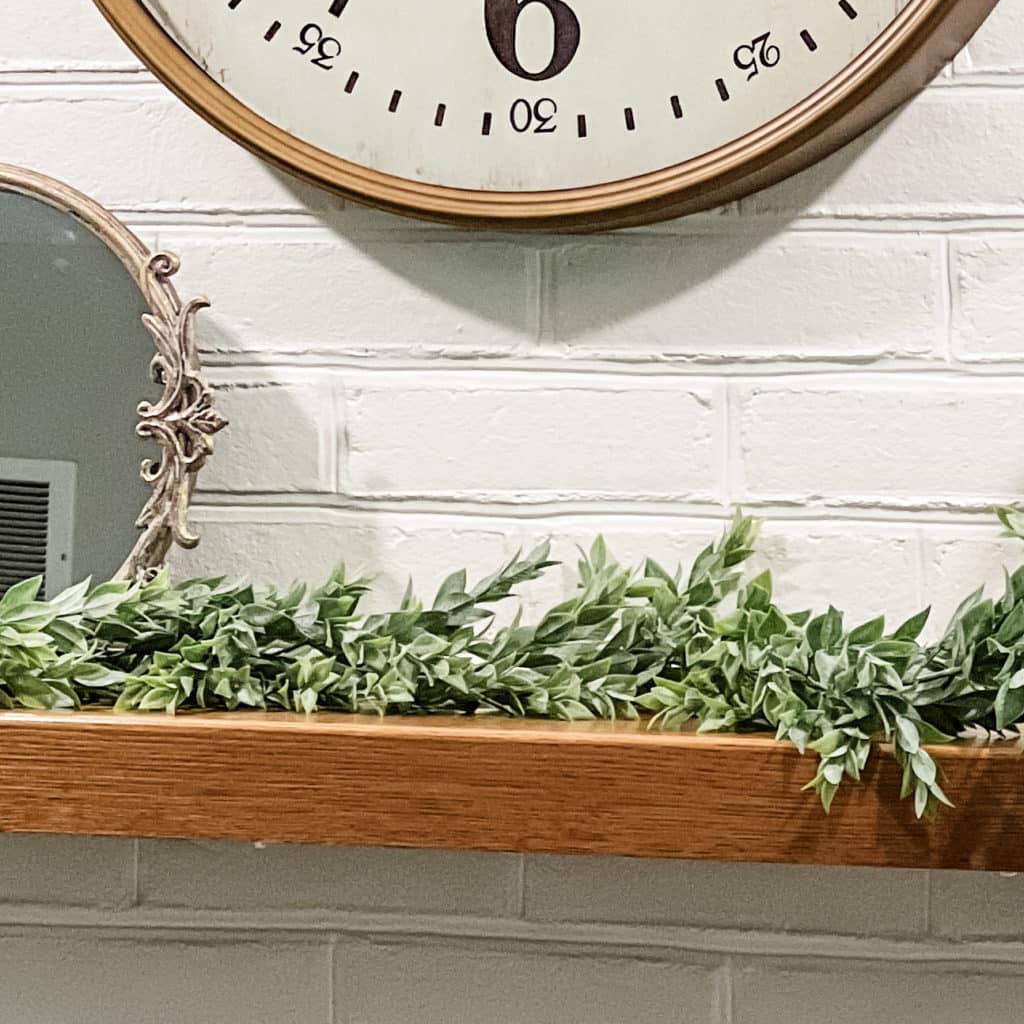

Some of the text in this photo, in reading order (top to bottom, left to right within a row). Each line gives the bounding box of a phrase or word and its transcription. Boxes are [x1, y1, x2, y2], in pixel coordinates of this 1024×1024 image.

[292, 23, 342, 71] 35
[733, 31, 781, 82] 25
[509, 97, 558, 134] 30
